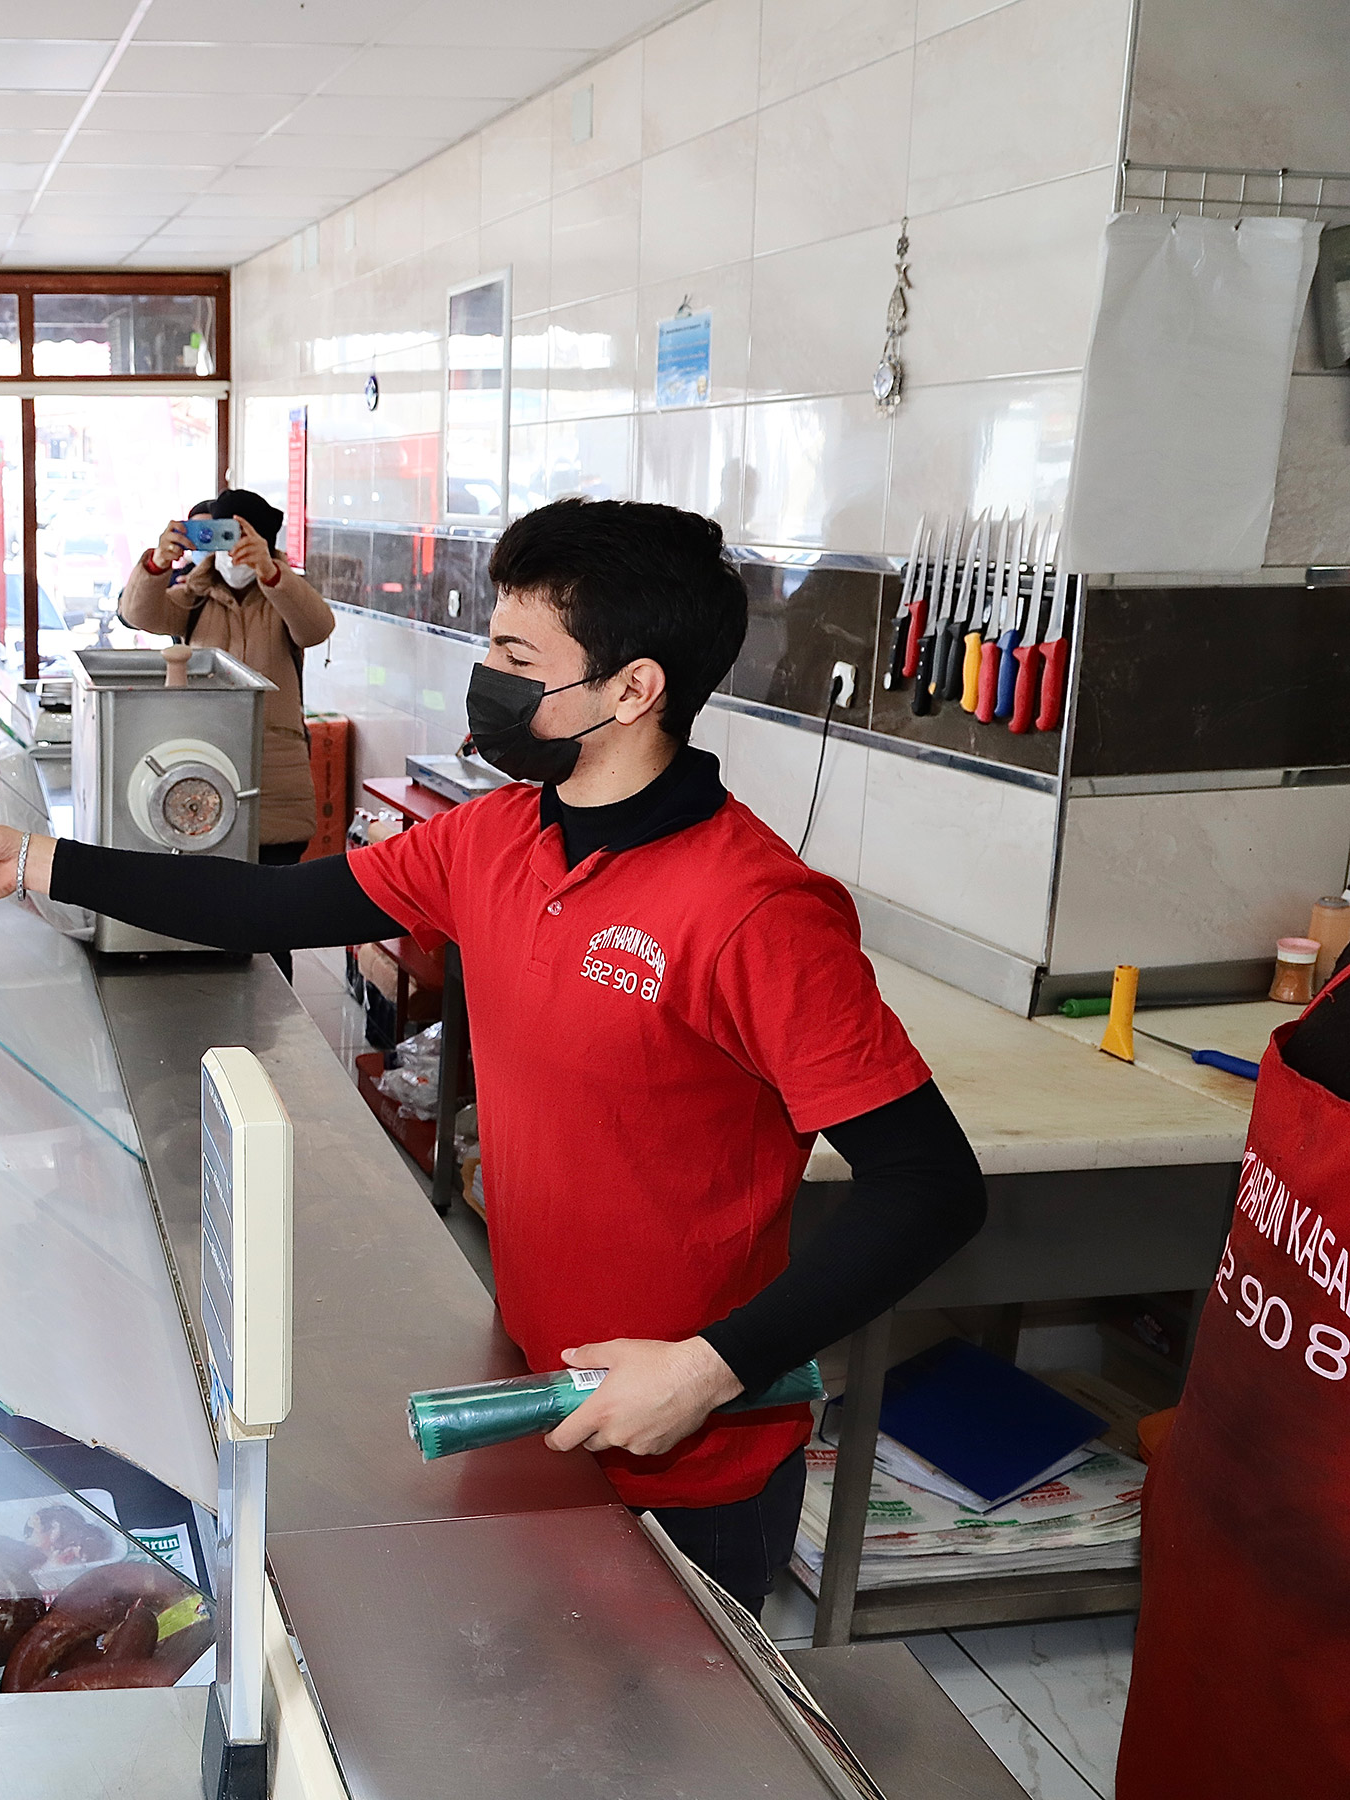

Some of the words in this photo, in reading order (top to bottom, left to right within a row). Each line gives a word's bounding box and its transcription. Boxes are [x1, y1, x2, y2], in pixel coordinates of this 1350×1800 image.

[580, 956, 613, 986] 582
[612, 968, 638, 994] 90
[640, 978, 661, 1003] 81
[1237, 1158, 1290, 1247] HARUN
[1286, 1198, 1350, 1318] KASA
[1236, 1274, 1293, 1350] 90
